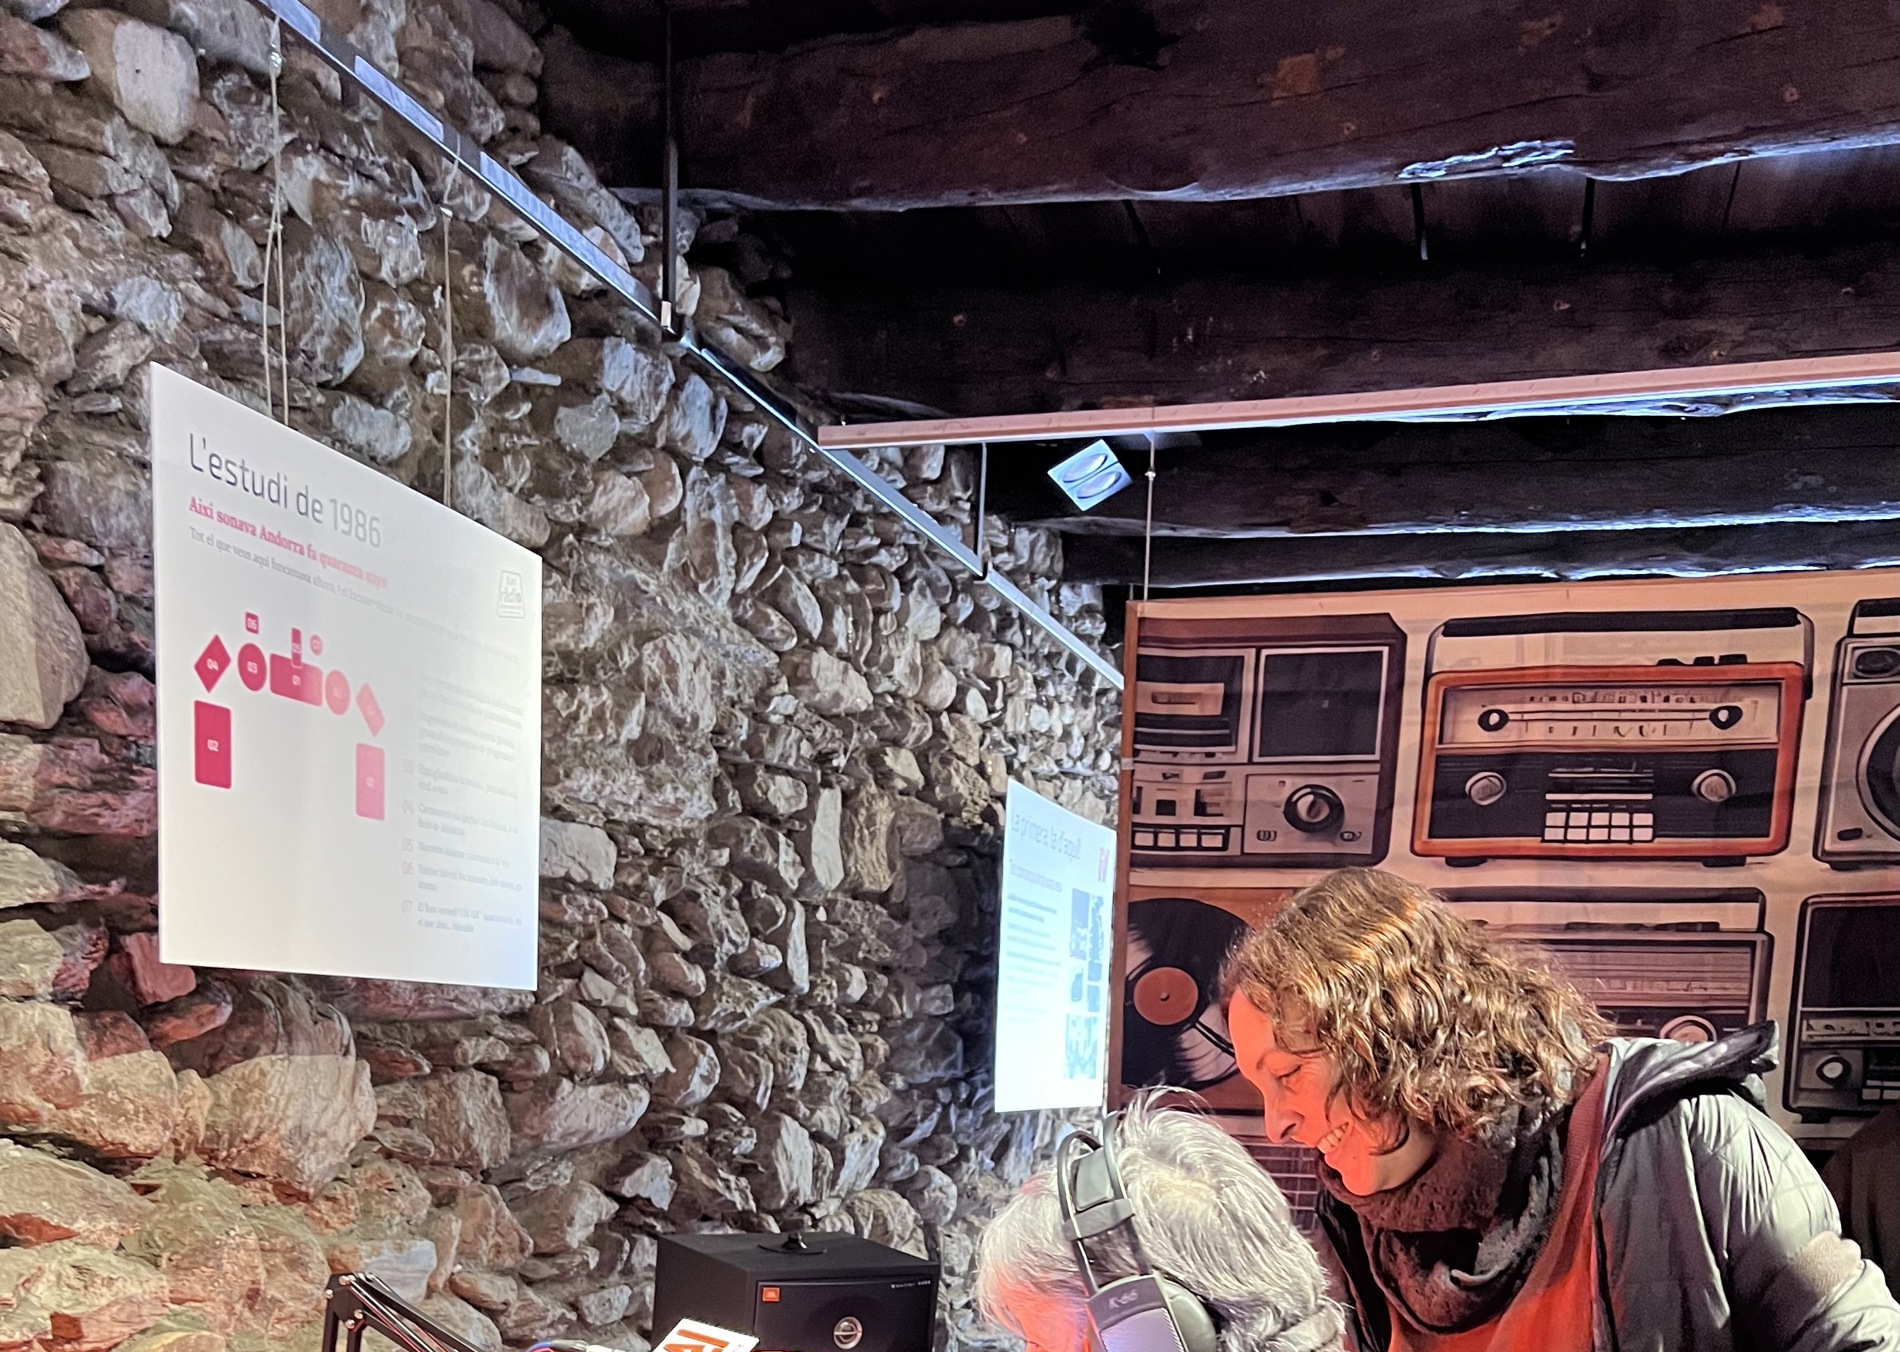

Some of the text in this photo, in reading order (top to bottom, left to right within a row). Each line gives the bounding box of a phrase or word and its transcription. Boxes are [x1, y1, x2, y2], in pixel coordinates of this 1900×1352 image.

[188, 432, 382, 549] L'estudi de 1986
[189, 496, 214, 521] Així
[216, 510, 258, 538] sonava
[260, 524, 305, 557] Andorra
[307, 543, 318, 561] fa
